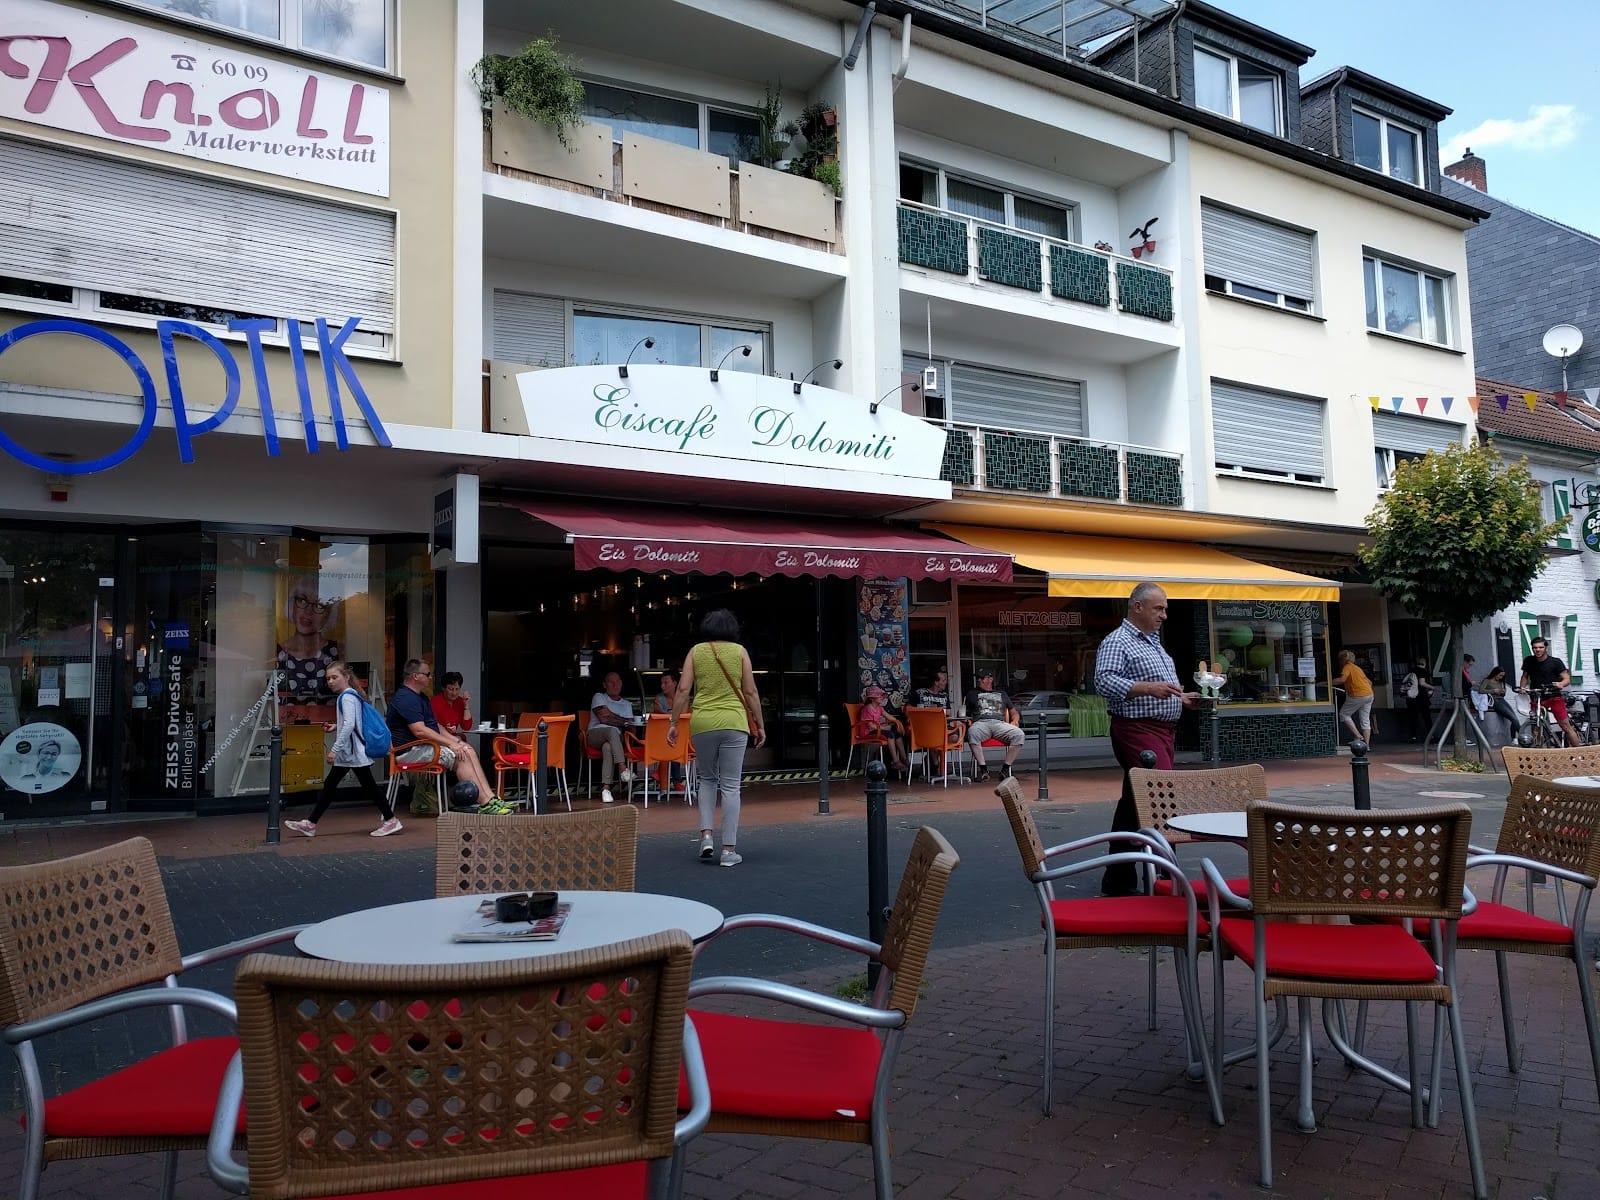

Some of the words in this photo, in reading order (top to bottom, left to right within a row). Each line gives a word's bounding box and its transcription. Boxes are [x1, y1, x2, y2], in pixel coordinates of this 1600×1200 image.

[0, 35, 374, 145] Knoll
[211, 63, 236, 77] 60
[244, 65, 269, 83] 09
[184, 130, 377, 164] Malerwerkstatt
[0, 317, 392, 476] OPTIK
[593, 383, 718, 450] Eiscafé
[748, 405, 897, 460] Dolomiti
[599, 543, 627, 561] Eis
[633, 544, 700, 563] Dolomiti
[775, 551, 799, 567] Eis
[804, 551, 860, 569] Dolomiti
[925, 557, 946, 572] Eis
[950, 557, 998, 574] Dolomiti
[165, 629, 190, 639] ZEISS
[998, 611, 1082, 626] METZGEREI
[167, 655, 182, 735] DriveSafe
[199, 671, 286, 775] www.optik-reckmann.de
[165, 742, 179, 789] ZEISS
[181, 710, 197, 789] Brillengläser
